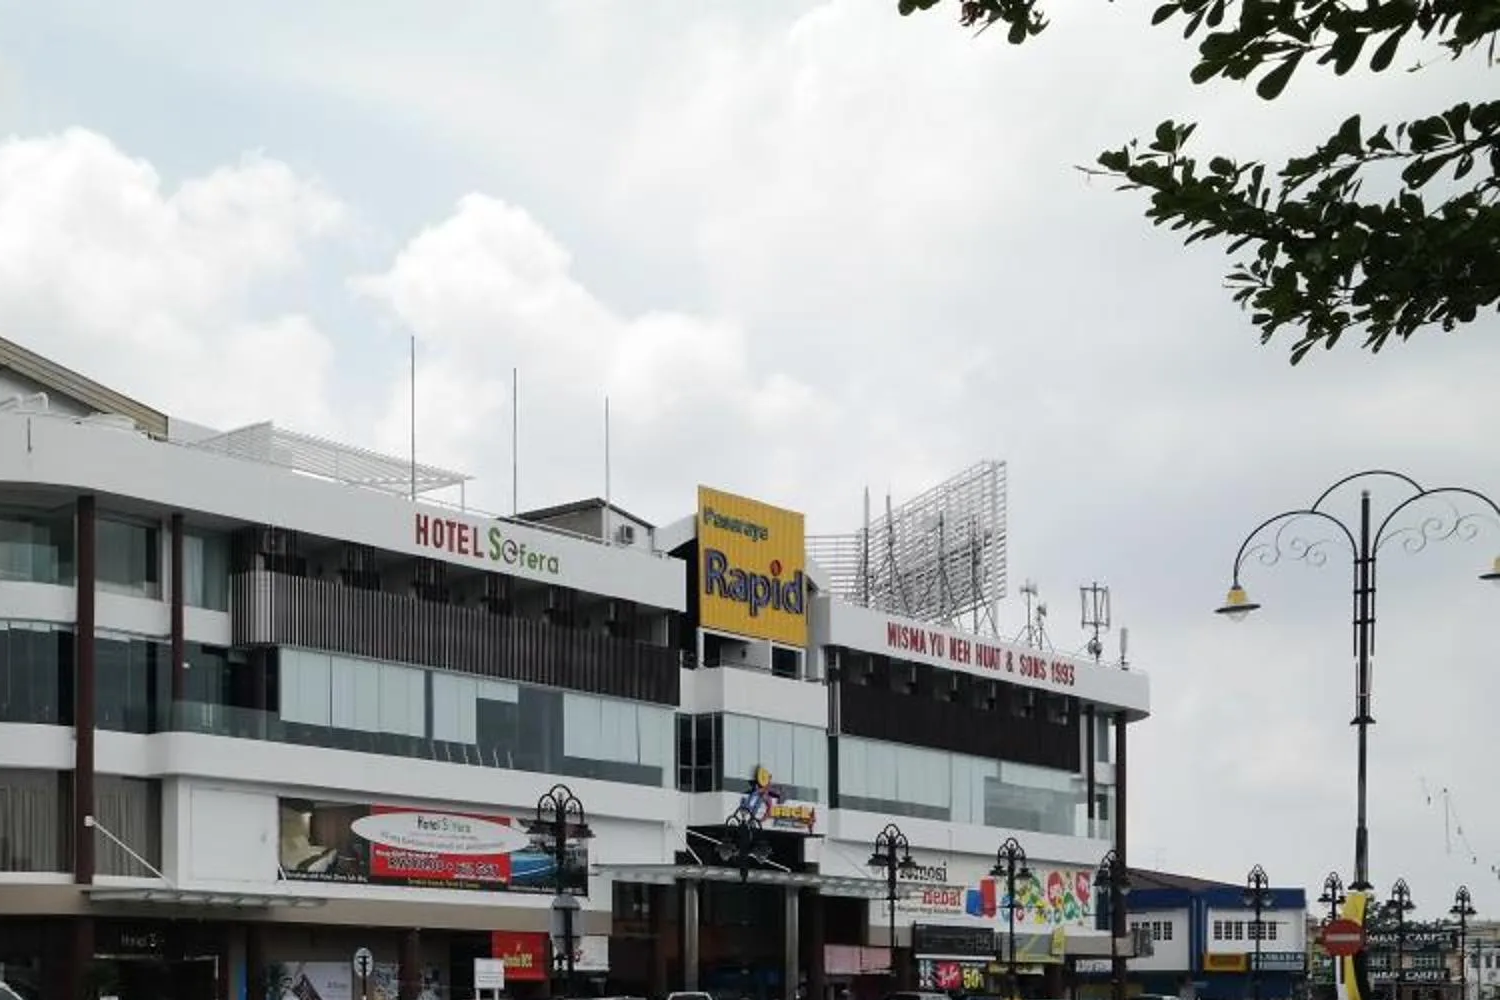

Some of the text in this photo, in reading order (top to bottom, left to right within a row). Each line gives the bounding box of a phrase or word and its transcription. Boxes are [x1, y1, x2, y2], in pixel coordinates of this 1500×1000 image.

[415, 513, 485, 558] HOTEL
[704, 548, 804, 617] Rapid
[929, 632, 945, 658] YU
[1019, 653, 1047, 681] SONS
